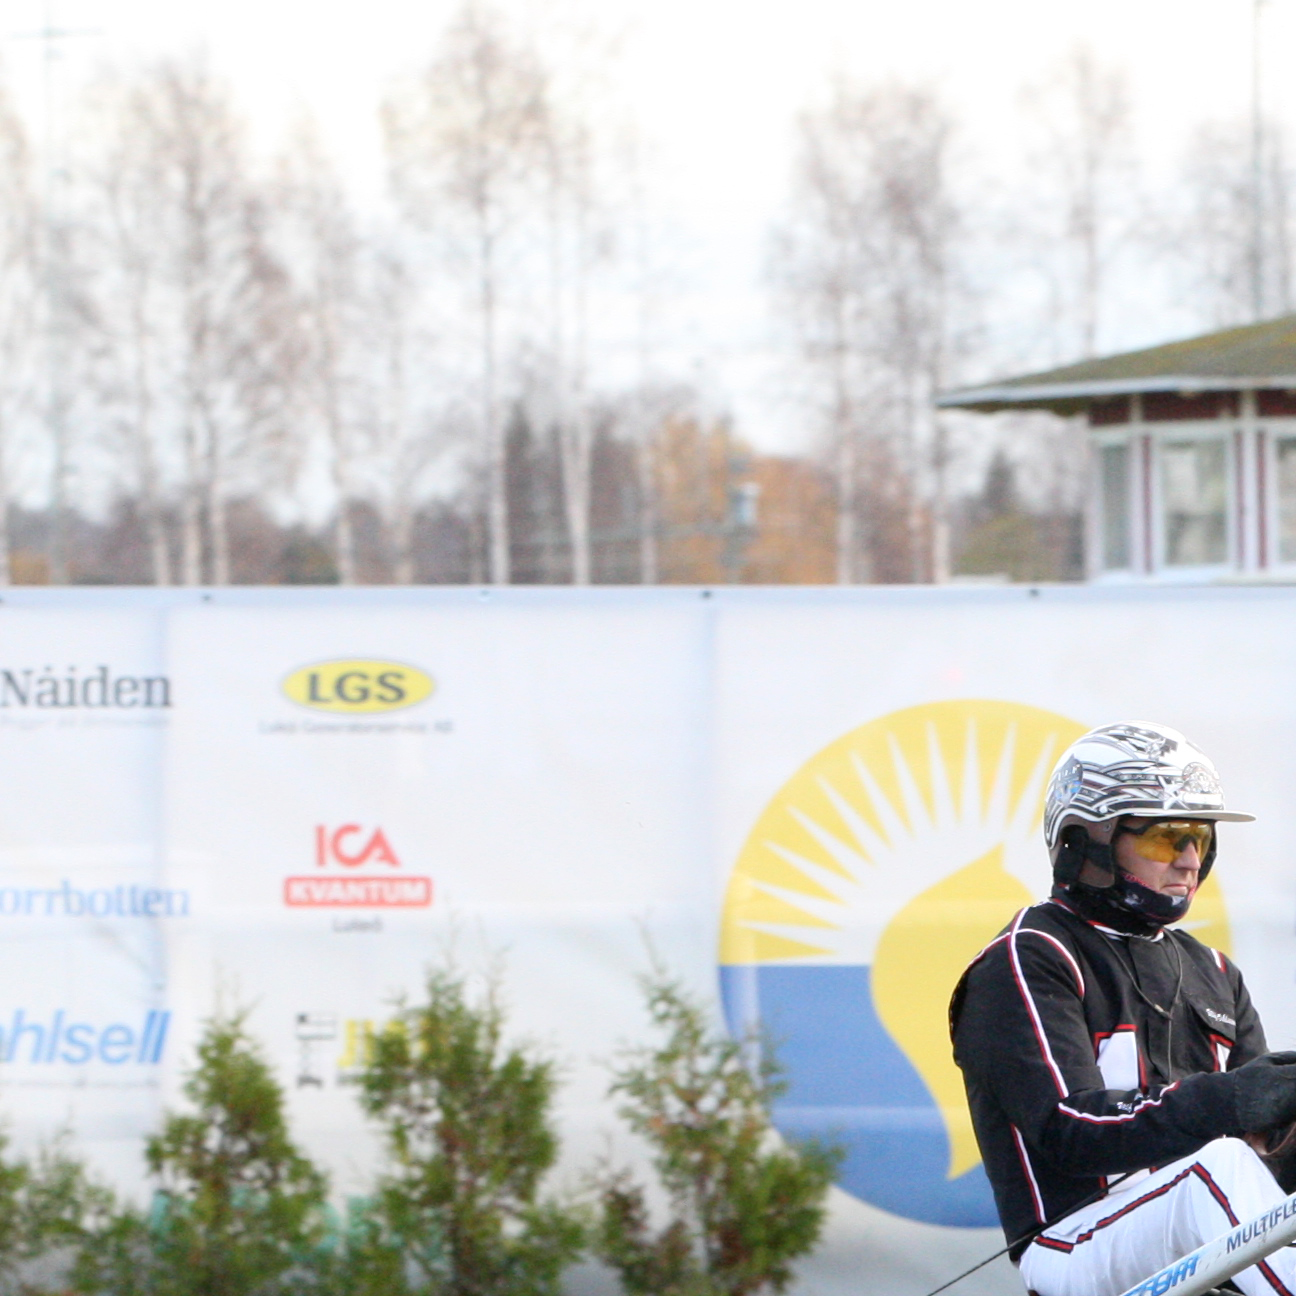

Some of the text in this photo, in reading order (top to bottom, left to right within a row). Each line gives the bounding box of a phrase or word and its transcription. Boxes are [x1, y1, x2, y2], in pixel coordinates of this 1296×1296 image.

[308, 672, 406, 703] LGS
[315, 825, 400, 868] ICA
[290, 882, 426, 900] KVANTUM
